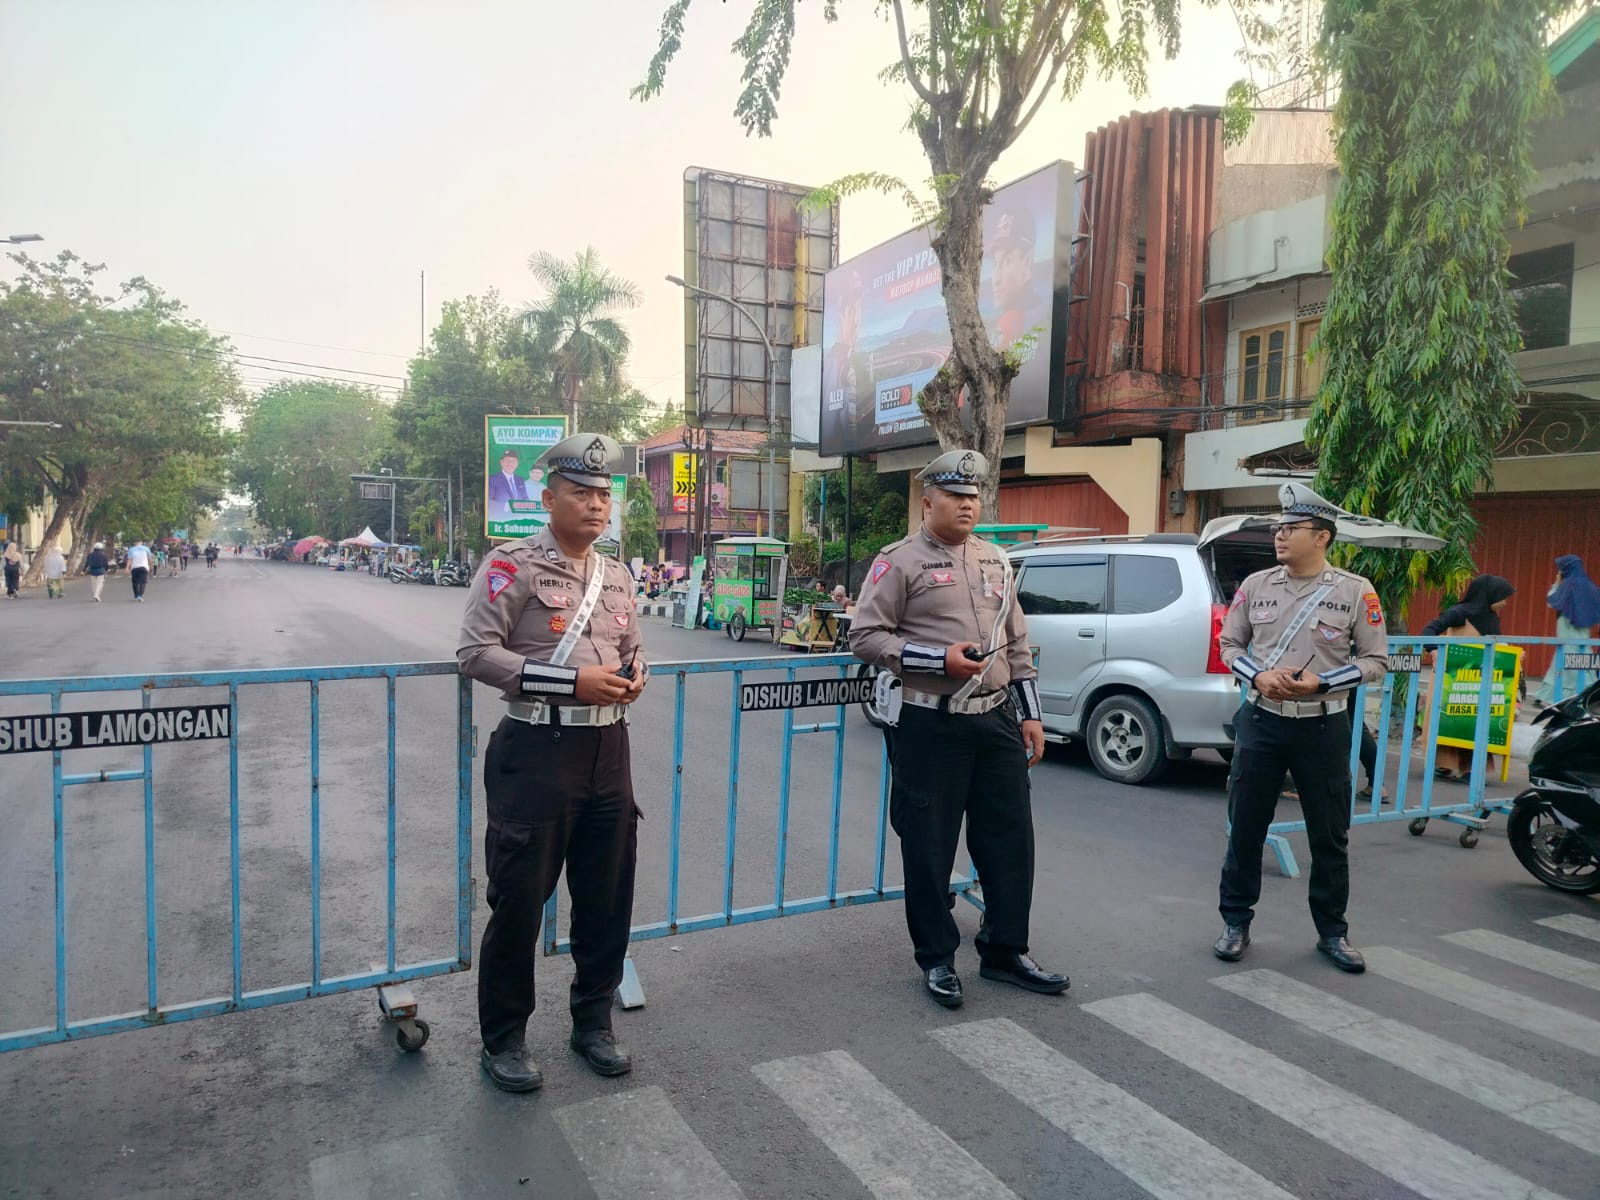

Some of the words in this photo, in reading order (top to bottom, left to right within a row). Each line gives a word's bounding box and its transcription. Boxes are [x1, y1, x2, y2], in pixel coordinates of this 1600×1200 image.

[896, 257, 913, 280] VIP
[829, 389, 844, 403] ALEX
[881, 389, 900, 403] BOLD
[497, 428, 516, 438] AYO
[518, 428, 558, 439] KOMPAK
[494, 524, 503, 533] Ir.
[539, 579, 564, 588] HERU
[602, 584, 625, 593] POLRI
[1252, 600, 1278, 608] JAYA
[1319, 600, 1352, 613] POLRI
[1565, 654, 1590, 669] DISHUB
[743, 684, 802, 709] DISHUB
[1449, 694, 1479, 704] HARGA
[1450, 705, 1472, 714] RASA
[82, 708, 229, 746] LAMONGAN
